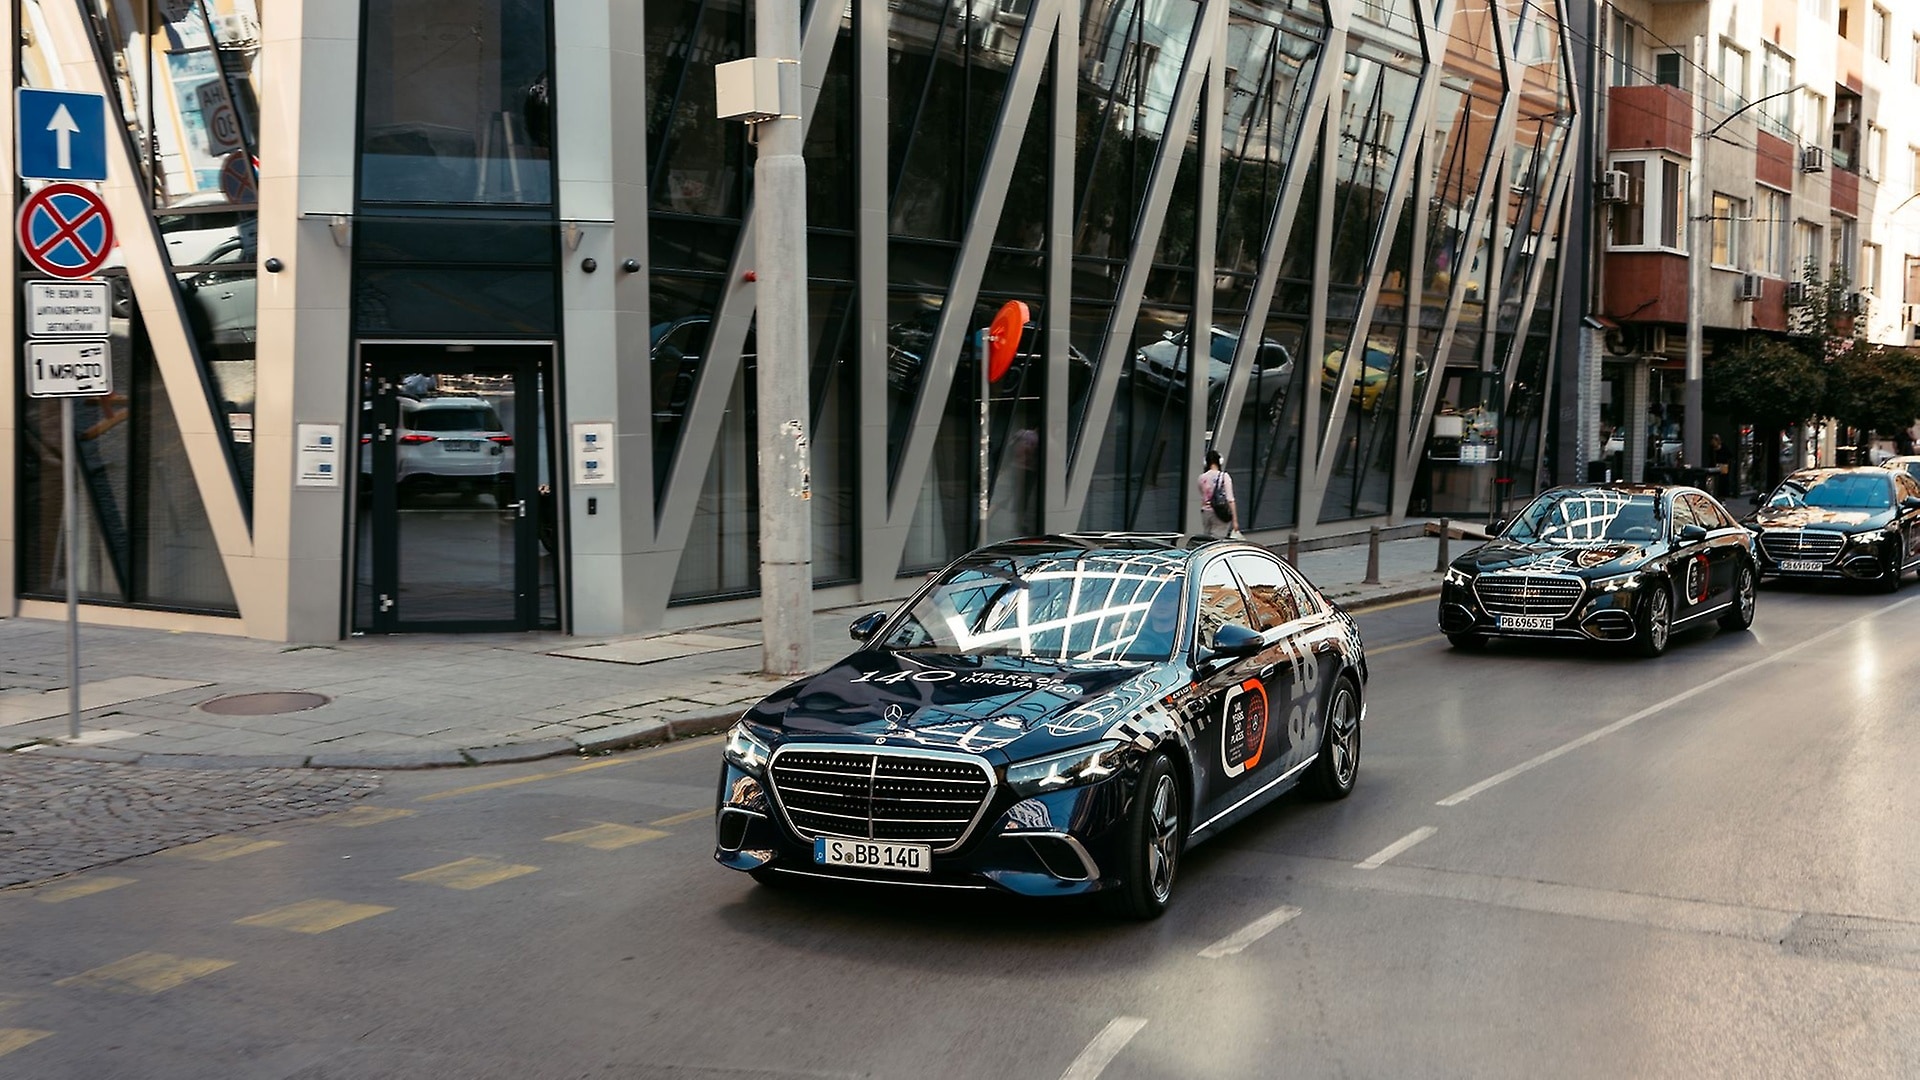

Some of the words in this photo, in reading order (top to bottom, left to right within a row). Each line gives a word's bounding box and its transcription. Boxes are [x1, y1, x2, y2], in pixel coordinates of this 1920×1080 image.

[35, 358, 43, 381] 1
[1502, 617, 1514, 627] PB
[1515, 618, 1537, 628] 6965
[1540, 618, 1552, 629] XE
[849, 669, 957, 685] 140
[972, 671, 1032, 681] YEARS
[959, 676, 1084, 695] INNOVATION
[831, 841, 843, 862] S
[855, 844, 880, 865] BB
[883, 846, 920, 868] 140
